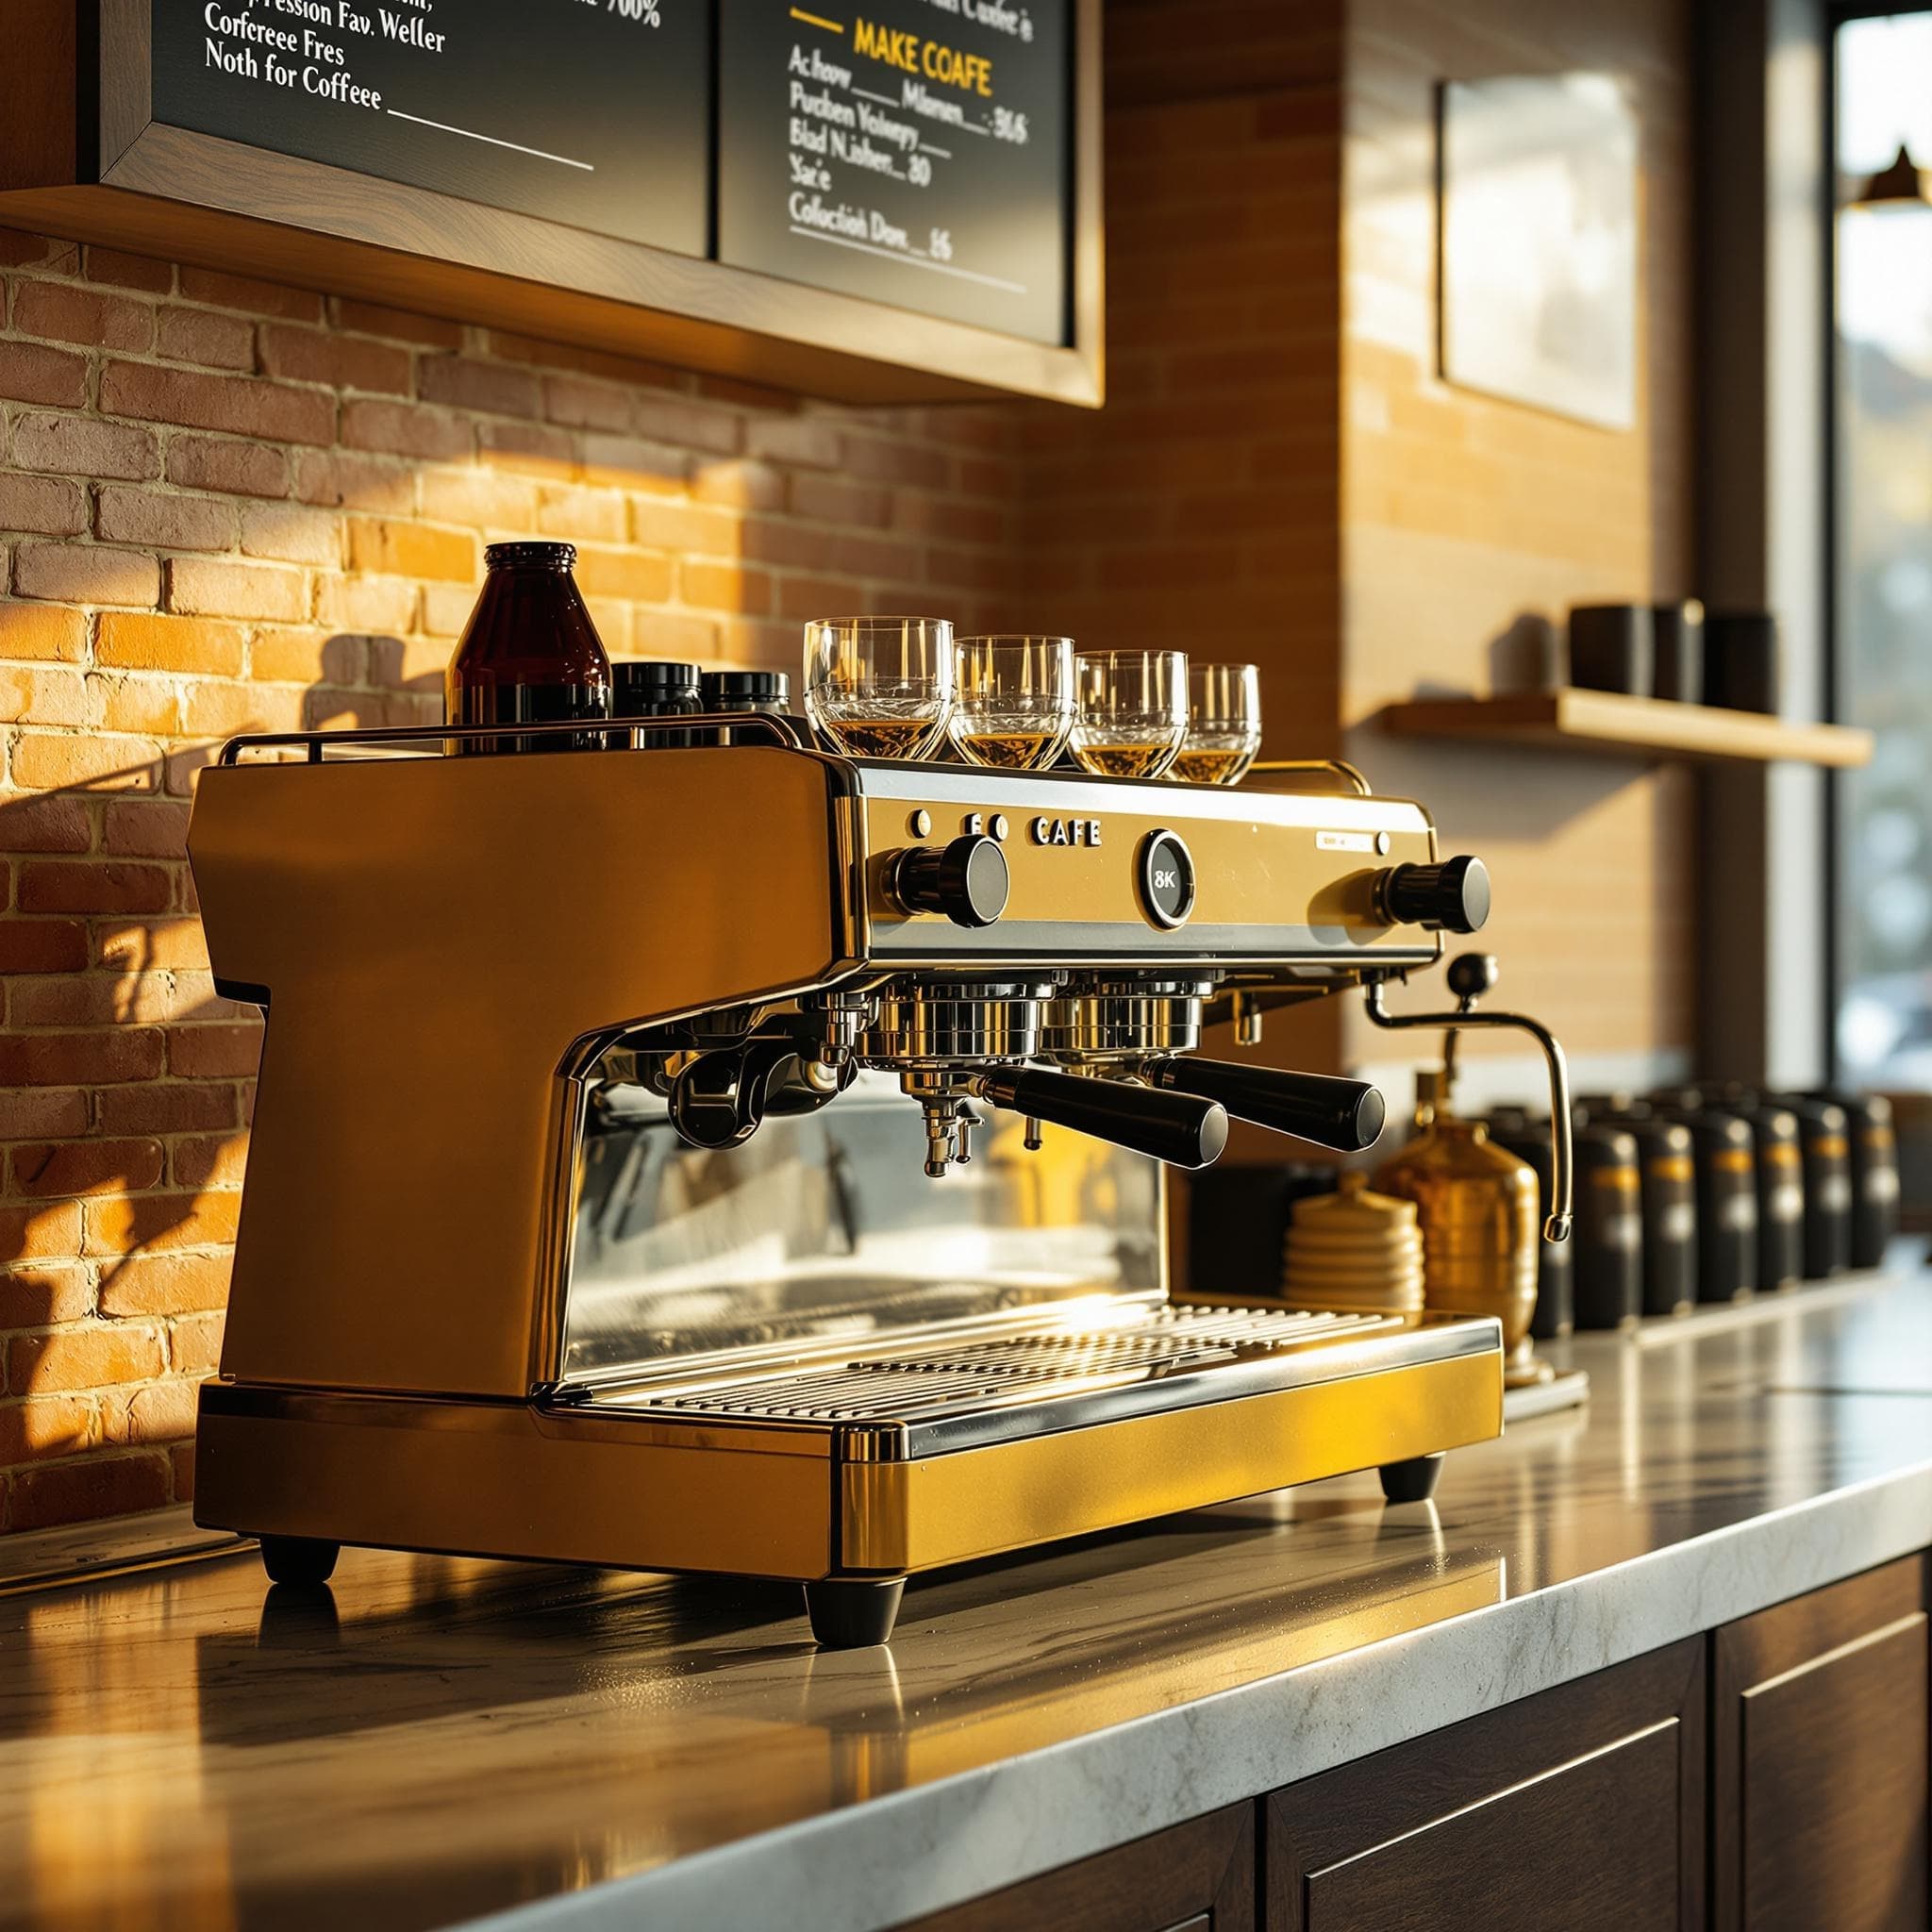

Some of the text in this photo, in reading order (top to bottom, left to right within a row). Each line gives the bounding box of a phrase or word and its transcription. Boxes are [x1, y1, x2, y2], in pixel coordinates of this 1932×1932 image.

[304, 29, 345, 66] Fres
[340, 0, 374, 36] Fav.
[378, 8, 447, 53] Weller
[206, 37, 382, 110] Noth for Coffeee
[854, 18, 919, 74] MAKE
[922, 41, 992, 97] COAFE
[1032, 816, 1103, 847] CAFE
[1154, 870, 1176, 890] 8K
